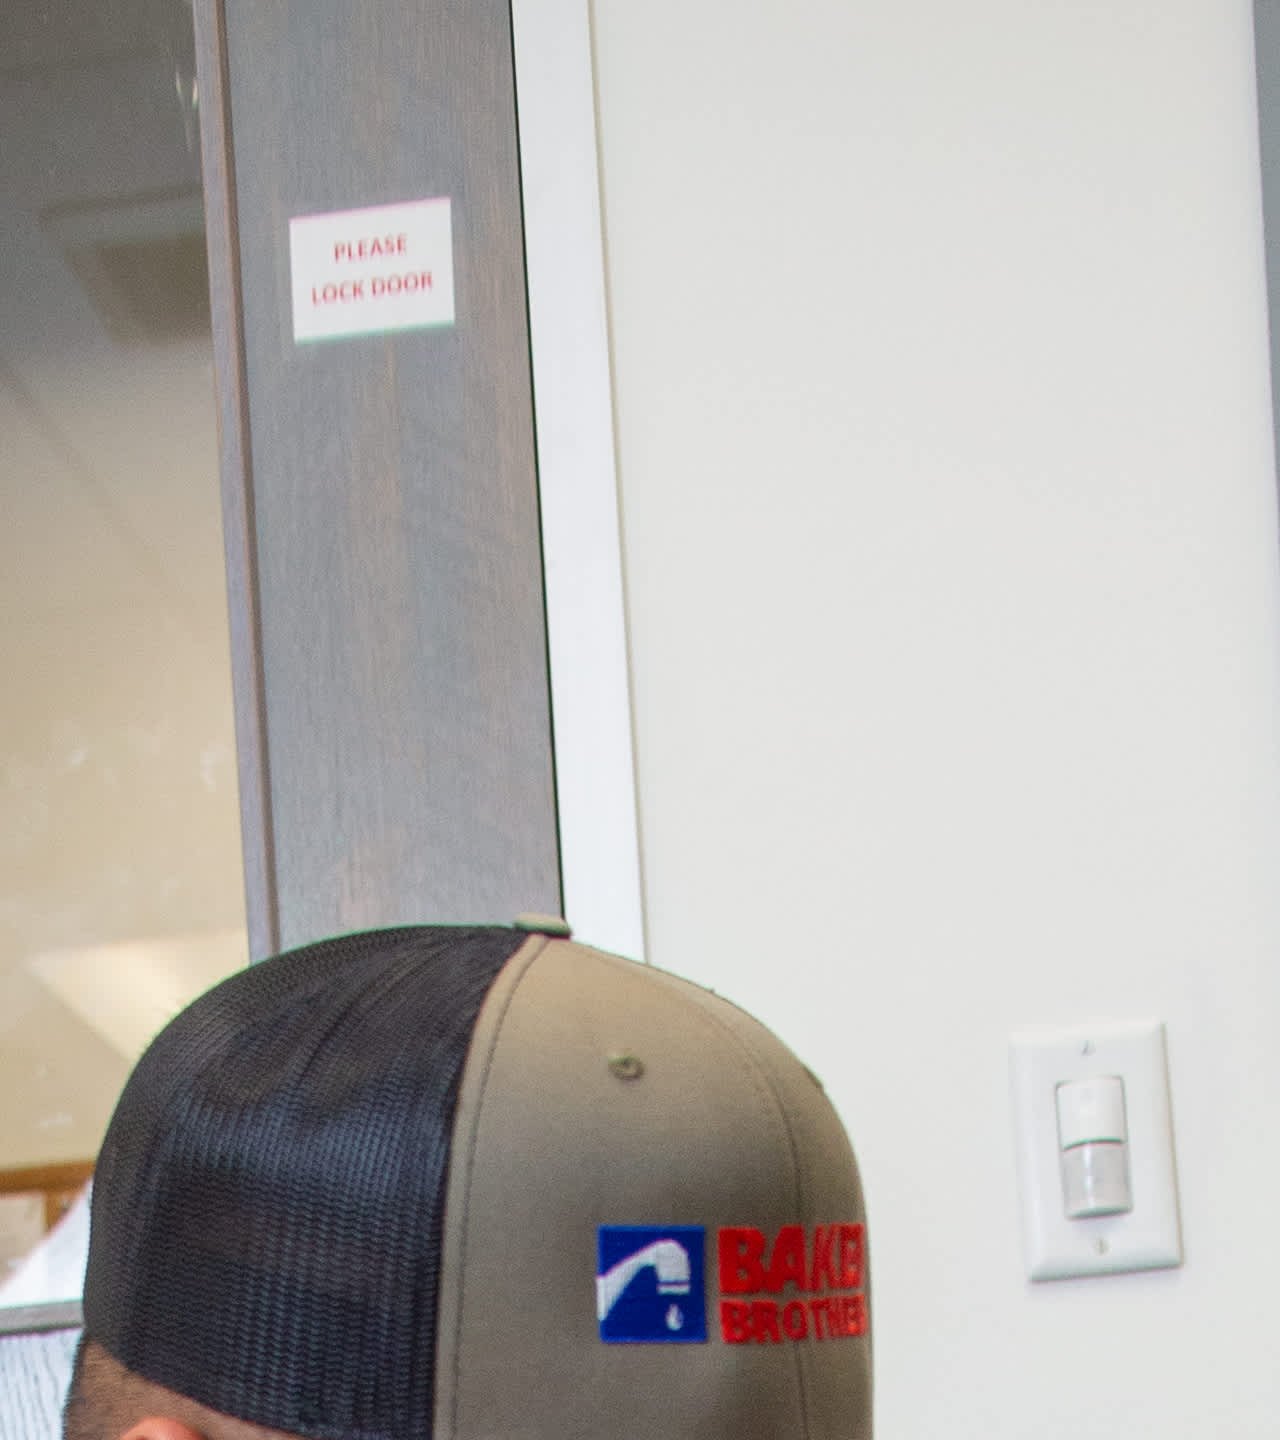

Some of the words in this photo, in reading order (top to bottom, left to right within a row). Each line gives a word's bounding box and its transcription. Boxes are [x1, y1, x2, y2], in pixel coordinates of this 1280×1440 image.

[333, 233, 407, 263] PLEASE
[311, 279, 364, 307] LOCK
[371, 271, 433, 298] DOOR
